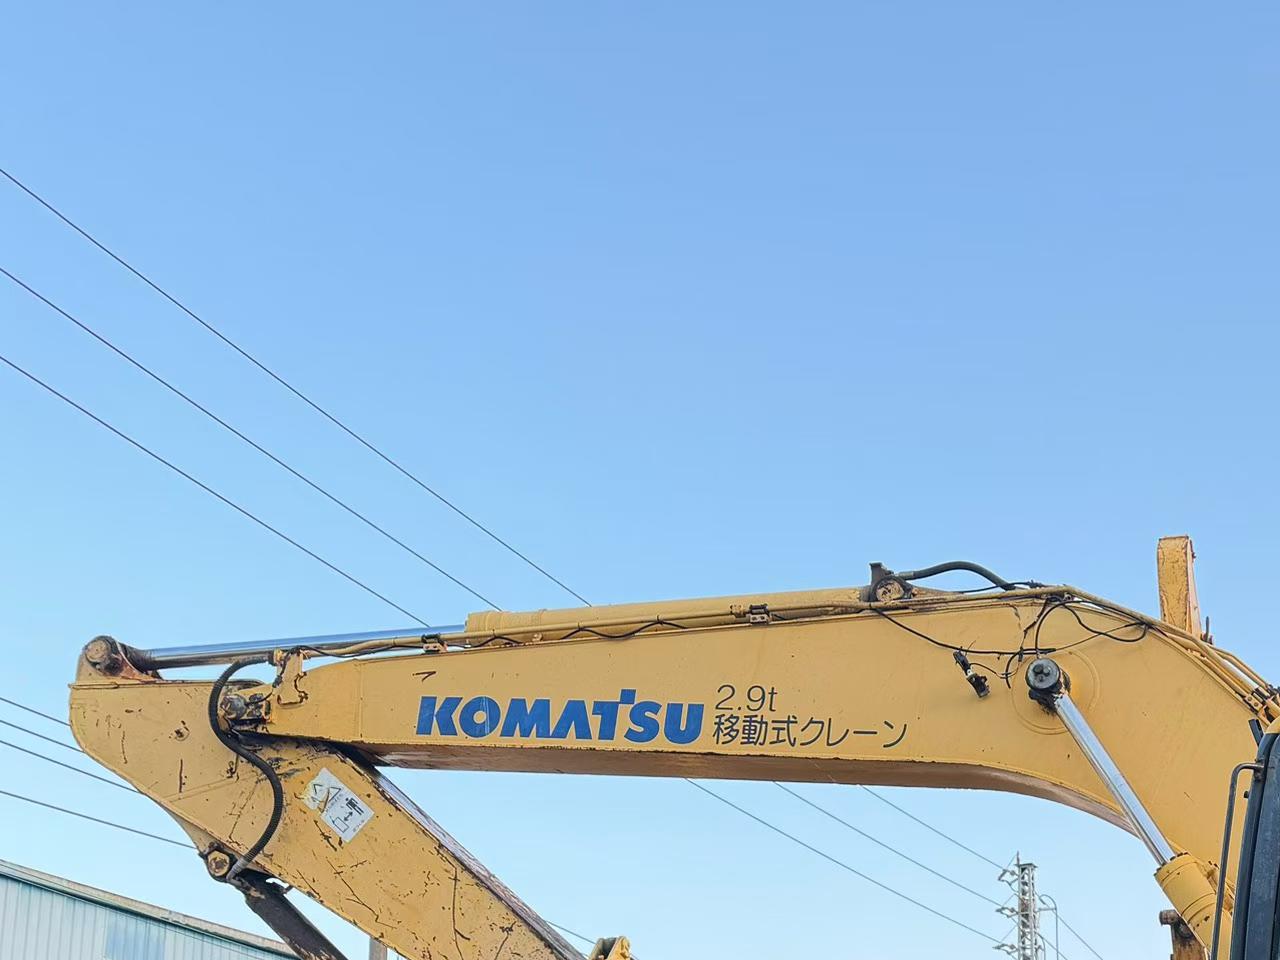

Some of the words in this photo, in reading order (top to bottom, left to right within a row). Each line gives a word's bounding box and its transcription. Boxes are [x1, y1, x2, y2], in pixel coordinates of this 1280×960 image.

[714, 684, 778, 713] 2.9t
[415, 689, 704, 745] KOMATSU
[713, 714, 908, 748] 移動式クレーン
